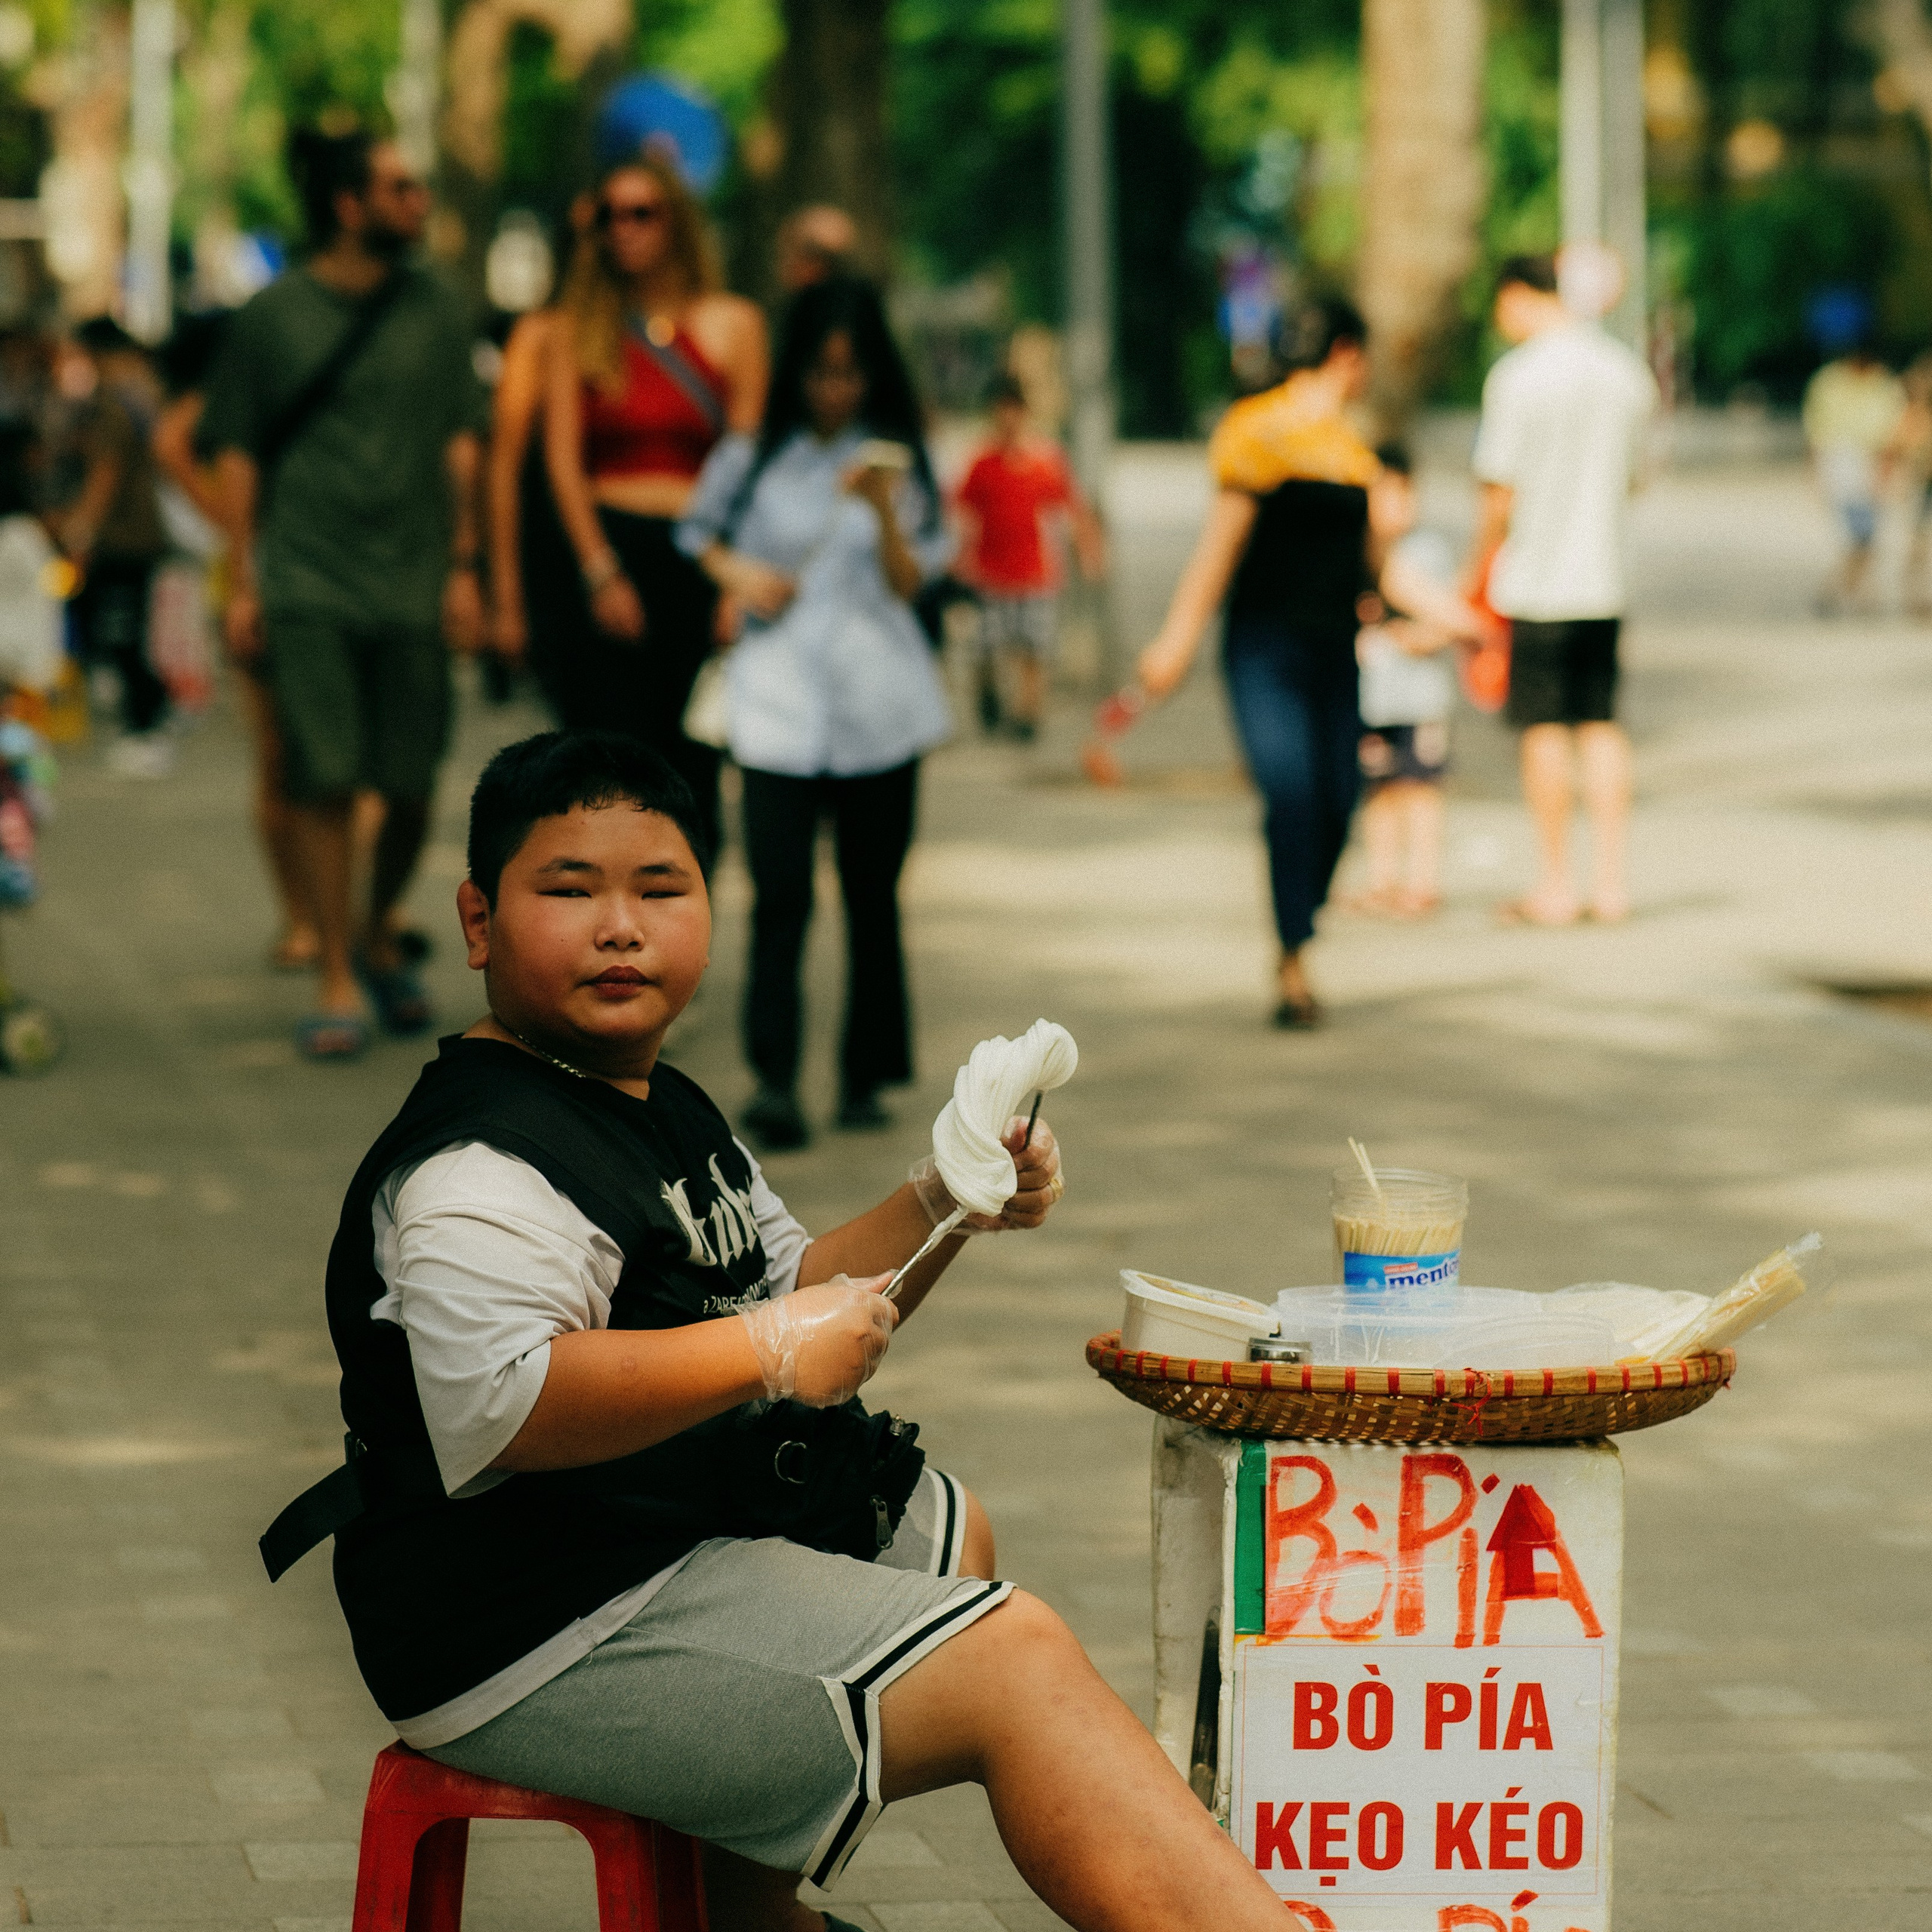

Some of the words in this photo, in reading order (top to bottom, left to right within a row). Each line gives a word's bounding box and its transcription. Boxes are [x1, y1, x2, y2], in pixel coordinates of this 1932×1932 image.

[1293, 1664, 1394, 1750] BÒ
[1425, 1667, 1553, 1750] PÍA
[1255, 1801, 1404, 1886] KẸO
[1435, 1787, 1583, 1870] KÉO
